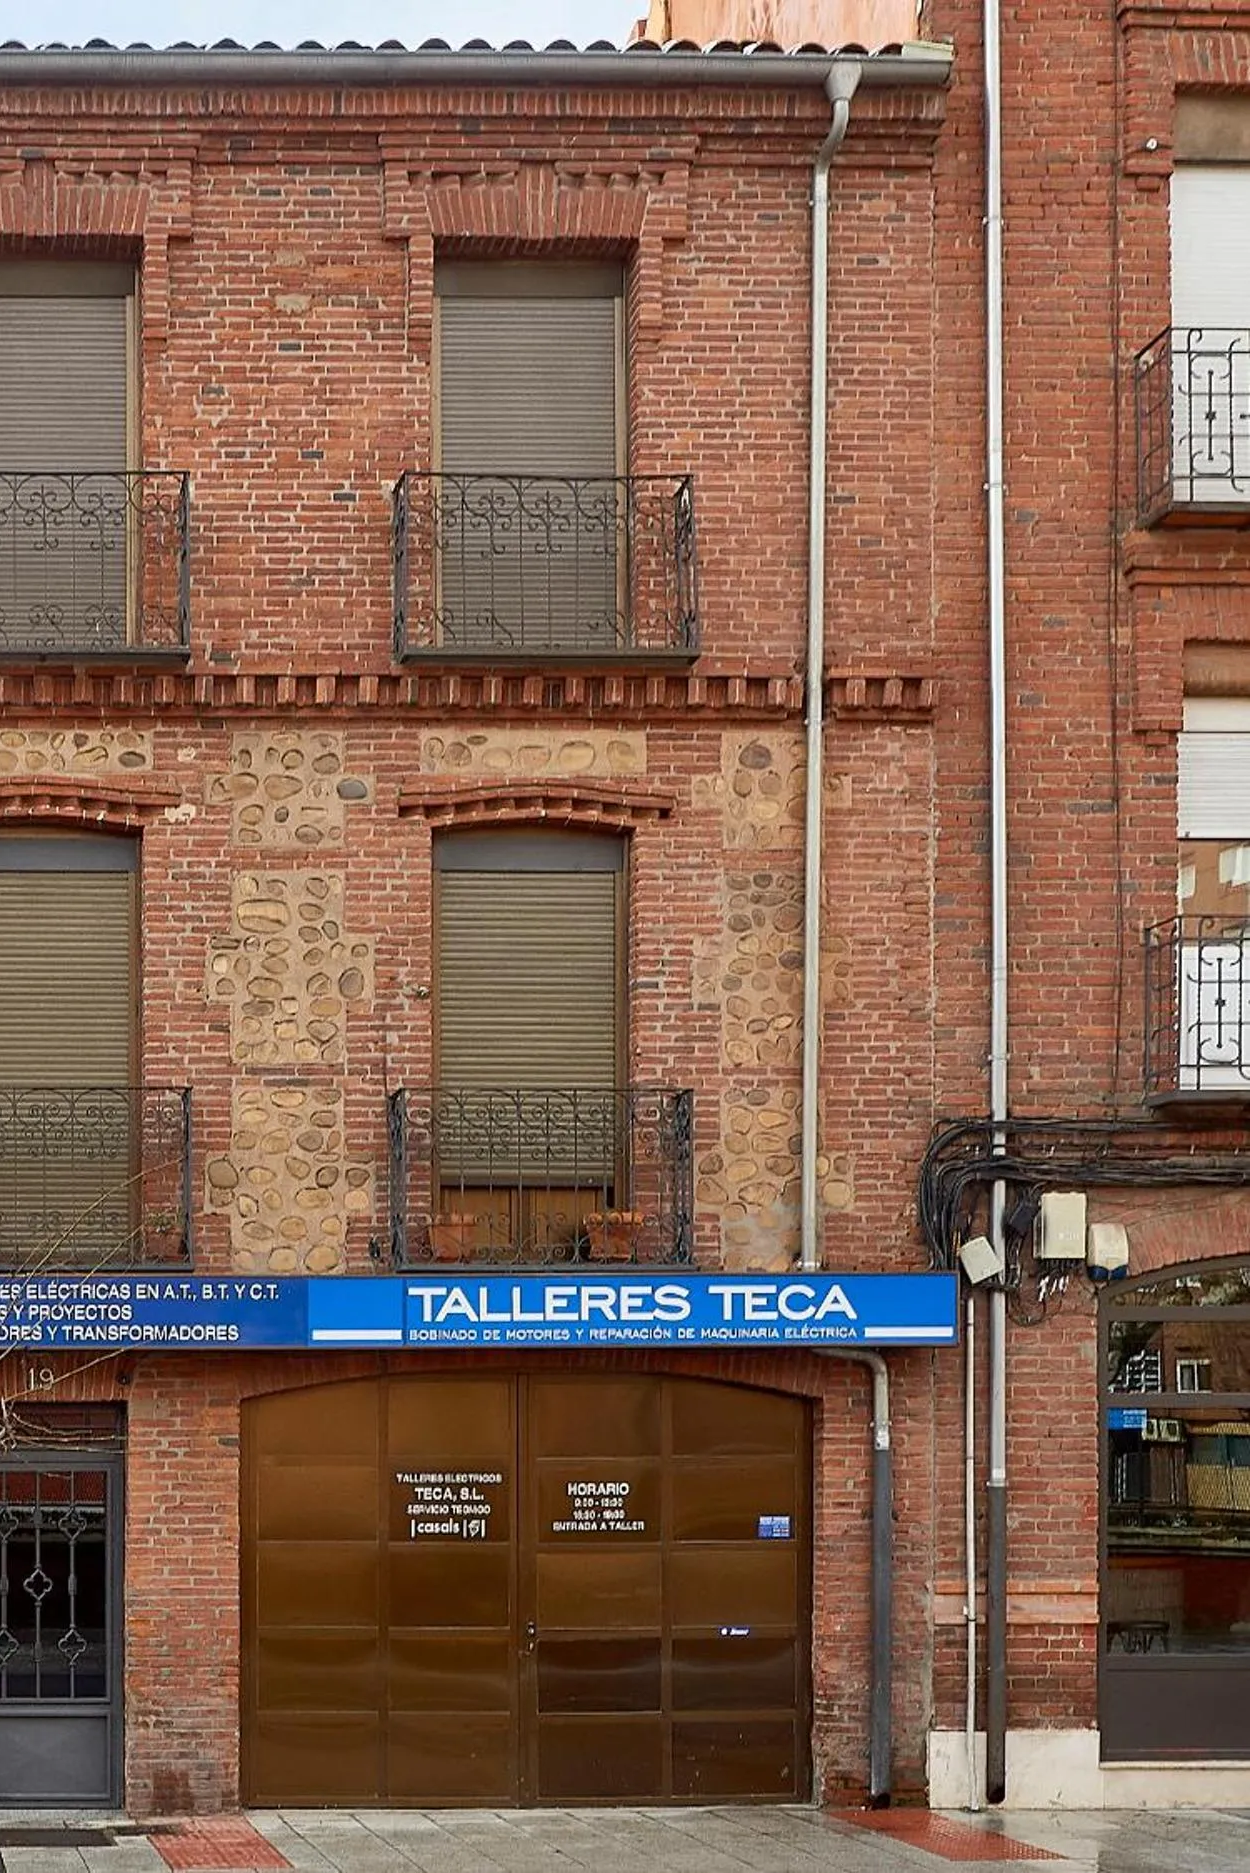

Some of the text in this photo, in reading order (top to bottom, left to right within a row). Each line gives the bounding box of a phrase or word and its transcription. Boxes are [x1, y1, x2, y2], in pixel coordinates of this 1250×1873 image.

[26, 1279, 131, 1300] ELÉCTRICAS
[136, 1283, 159, 1299] EN
[163, 1283, 197, 1302] A.T.,
[202, 1283, 229, 1299] B.T.
[234, 1283, 245, 1299] Y
[250, 1283, 279, 1299] C.T.
[408, 1284, 858, 1322] TALLERES TECA
[13, 1304, 24, 1320] Y
[28, 1304, 132, 1320] PROYECTOS
[48, 1325, 58, 1340] Y
[62, 1324, 239, 1341] TRANSFORMADORES
[409, 1324, 857, 1340] BOBINADO DE MOTORES Y REPARACIÓN DE MAQUINARIA ELÉCTRICA
[29, 1367, 54, 1391] 19
[414, 1487, 484, 1502] TECA, S.L.
[567, 1482, 630, 1496] HORARIO
[417, 1517, 460, 1534] casals
[552, 1521, 645, 1531] ENTRADA A TALLER
